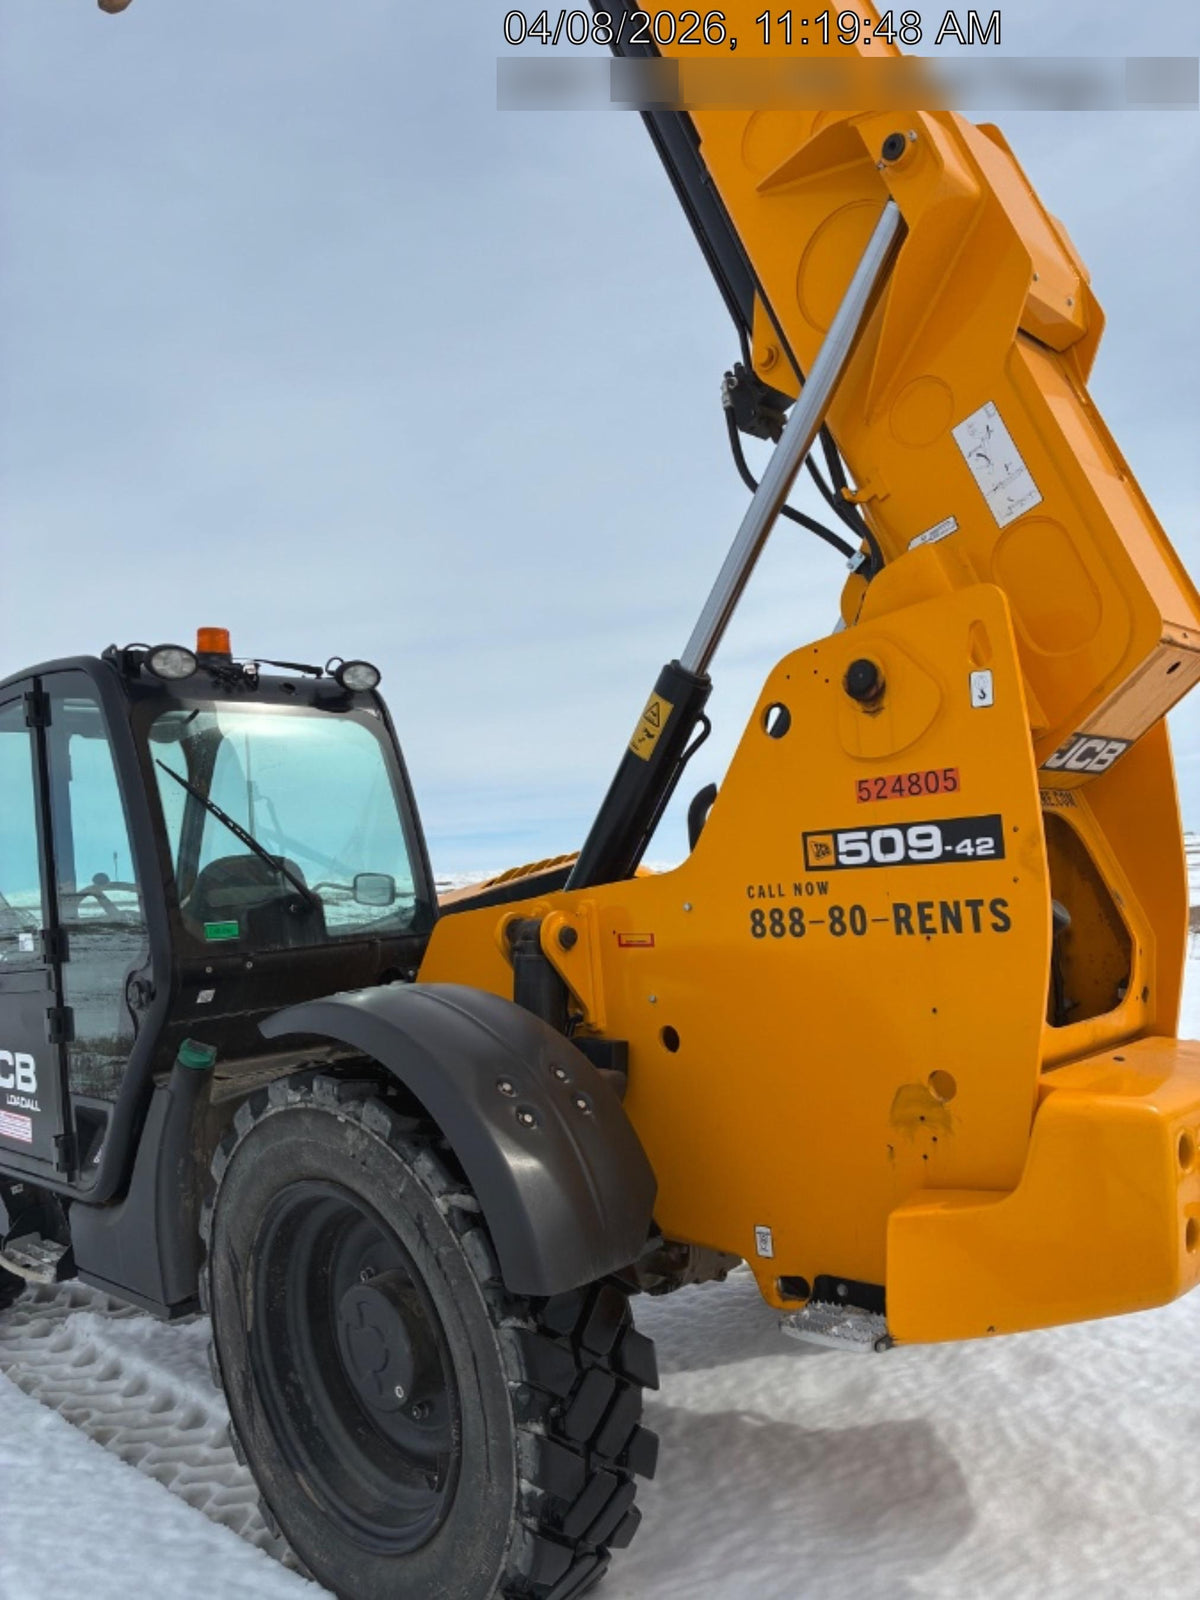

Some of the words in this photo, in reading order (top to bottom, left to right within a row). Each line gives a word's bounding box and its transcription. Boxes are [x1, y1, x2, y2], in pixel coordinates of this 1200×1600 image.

[1045, 737, 1128, 772] JCB
[857, 768, 957, 801] 524805
[836, 824, 996, 866] 509-42
[747, 882, 785, 899] CALL
[793, 881, 829, 897] NOW
[750, 898, 1012, 939] 888-80-RENTS
